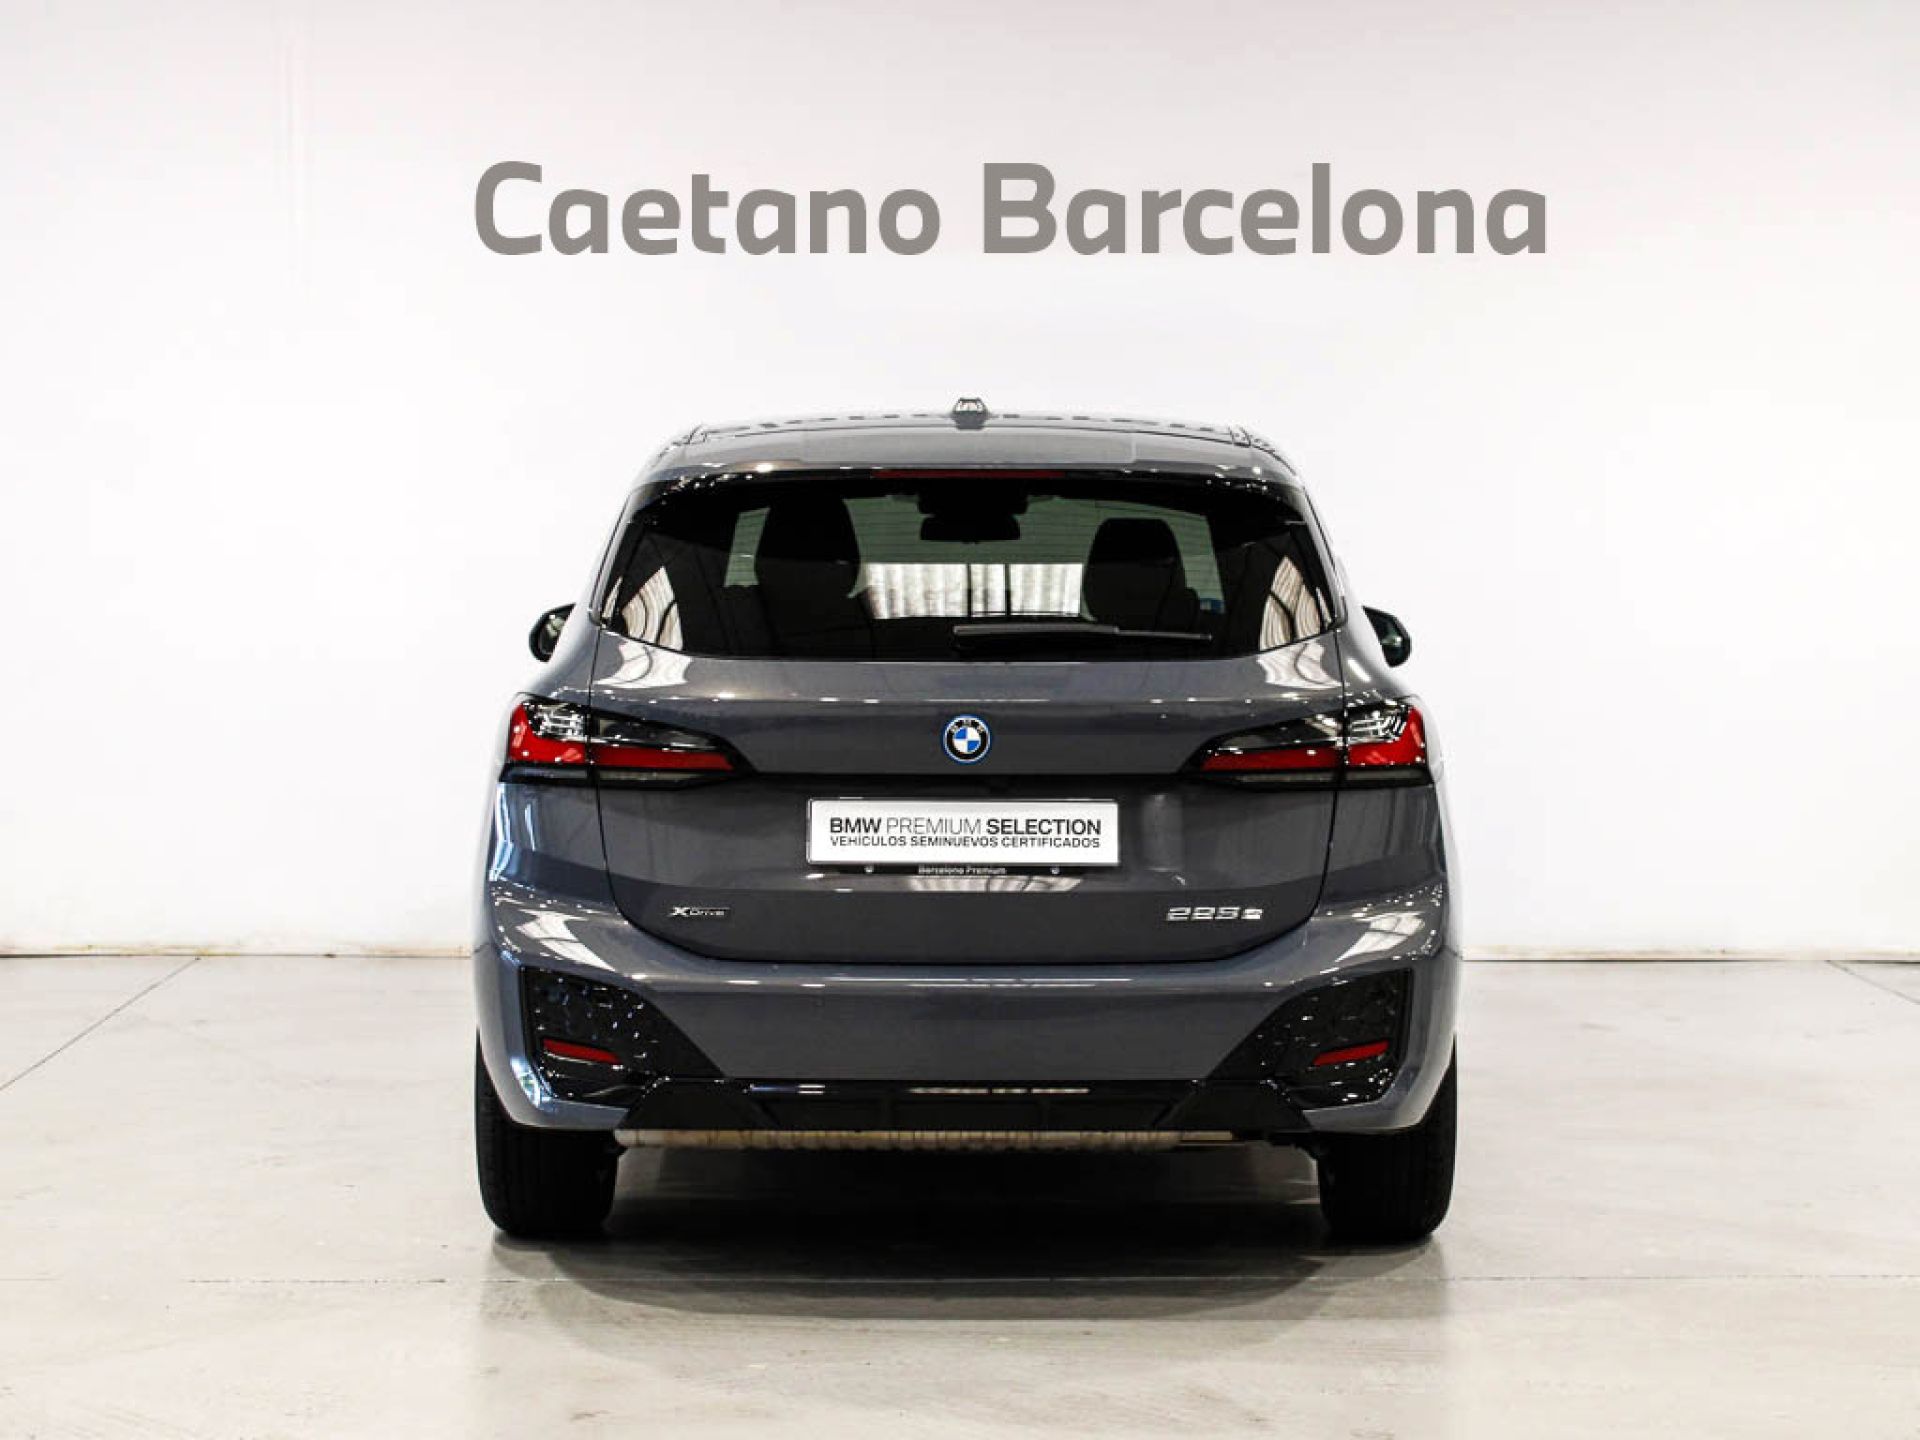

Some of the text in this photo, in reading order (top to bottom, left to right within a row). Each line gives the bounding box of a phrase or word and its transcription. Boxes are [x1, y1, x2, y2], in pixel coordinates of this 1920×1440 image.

[830, 818, 1102, 836] BMW PREMIUM SELECTION
[910, 837, 998, 848] SEMINUEVOS
[1001, 837, 1100, 849] CERTIFICADOS
